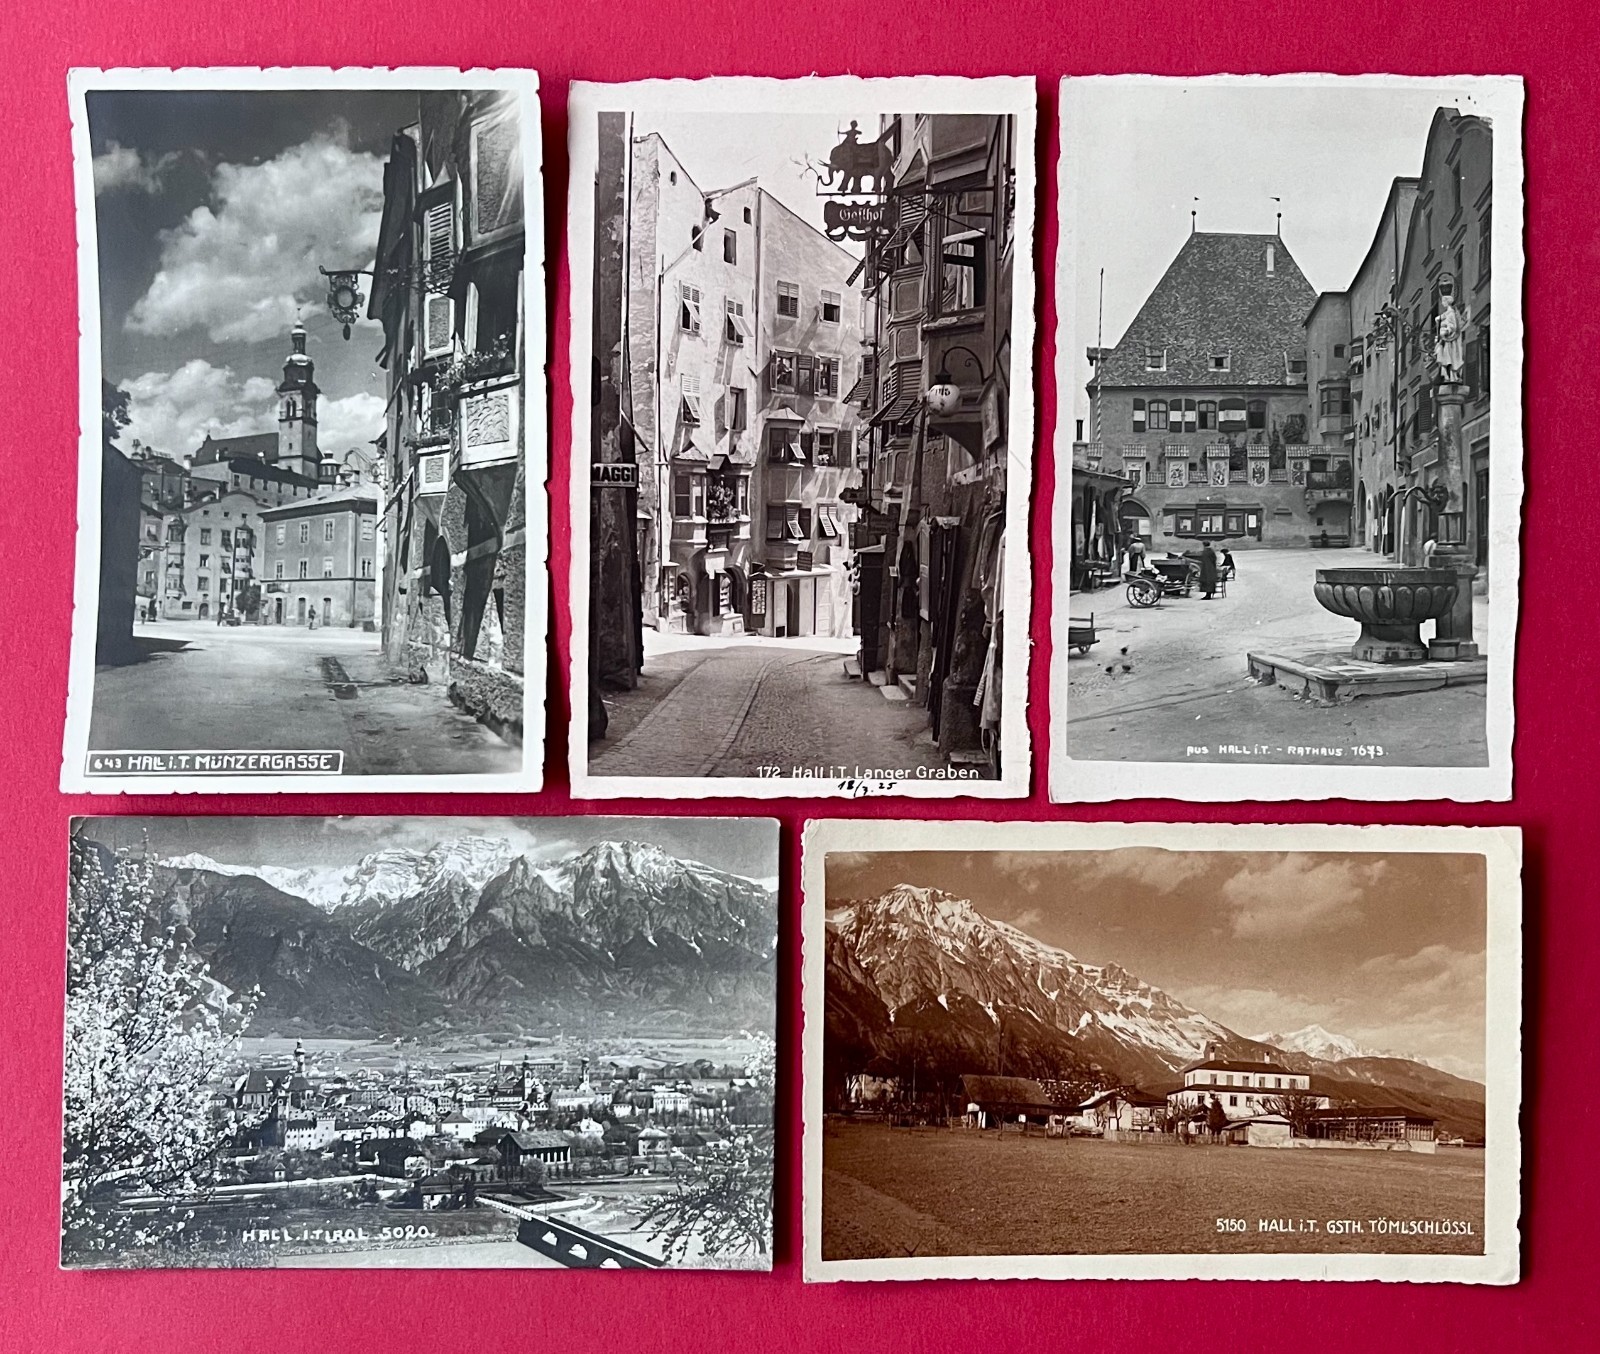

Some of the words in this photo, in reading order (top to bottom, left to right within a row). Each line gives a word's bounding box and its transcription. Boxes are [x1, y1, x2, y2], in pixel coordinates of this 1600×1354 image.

[1218, 745, 1250, 754] HALL
[1287, 746, 1344, 757] RATHAUS
[94, 755, 122, 769] 643
[127, 755, 167, 771] HALL
[195, 754, 333, 770] MÜNZERGASSE
[756, 766, 781, 778] 172
[792, 766, 824, 779] Hall
[854, 766, 911, 779] Langer
[915, 764, 980, 779] Graben
[1216, 1219, 1247, 1232] 5150
[1258, 1219, 1296, 1233] HALL
[1326, 1219, 1364, 1235] GSTH.
[1368, 1217, 1475, 1235] TÖMLSCHLÖSSL
